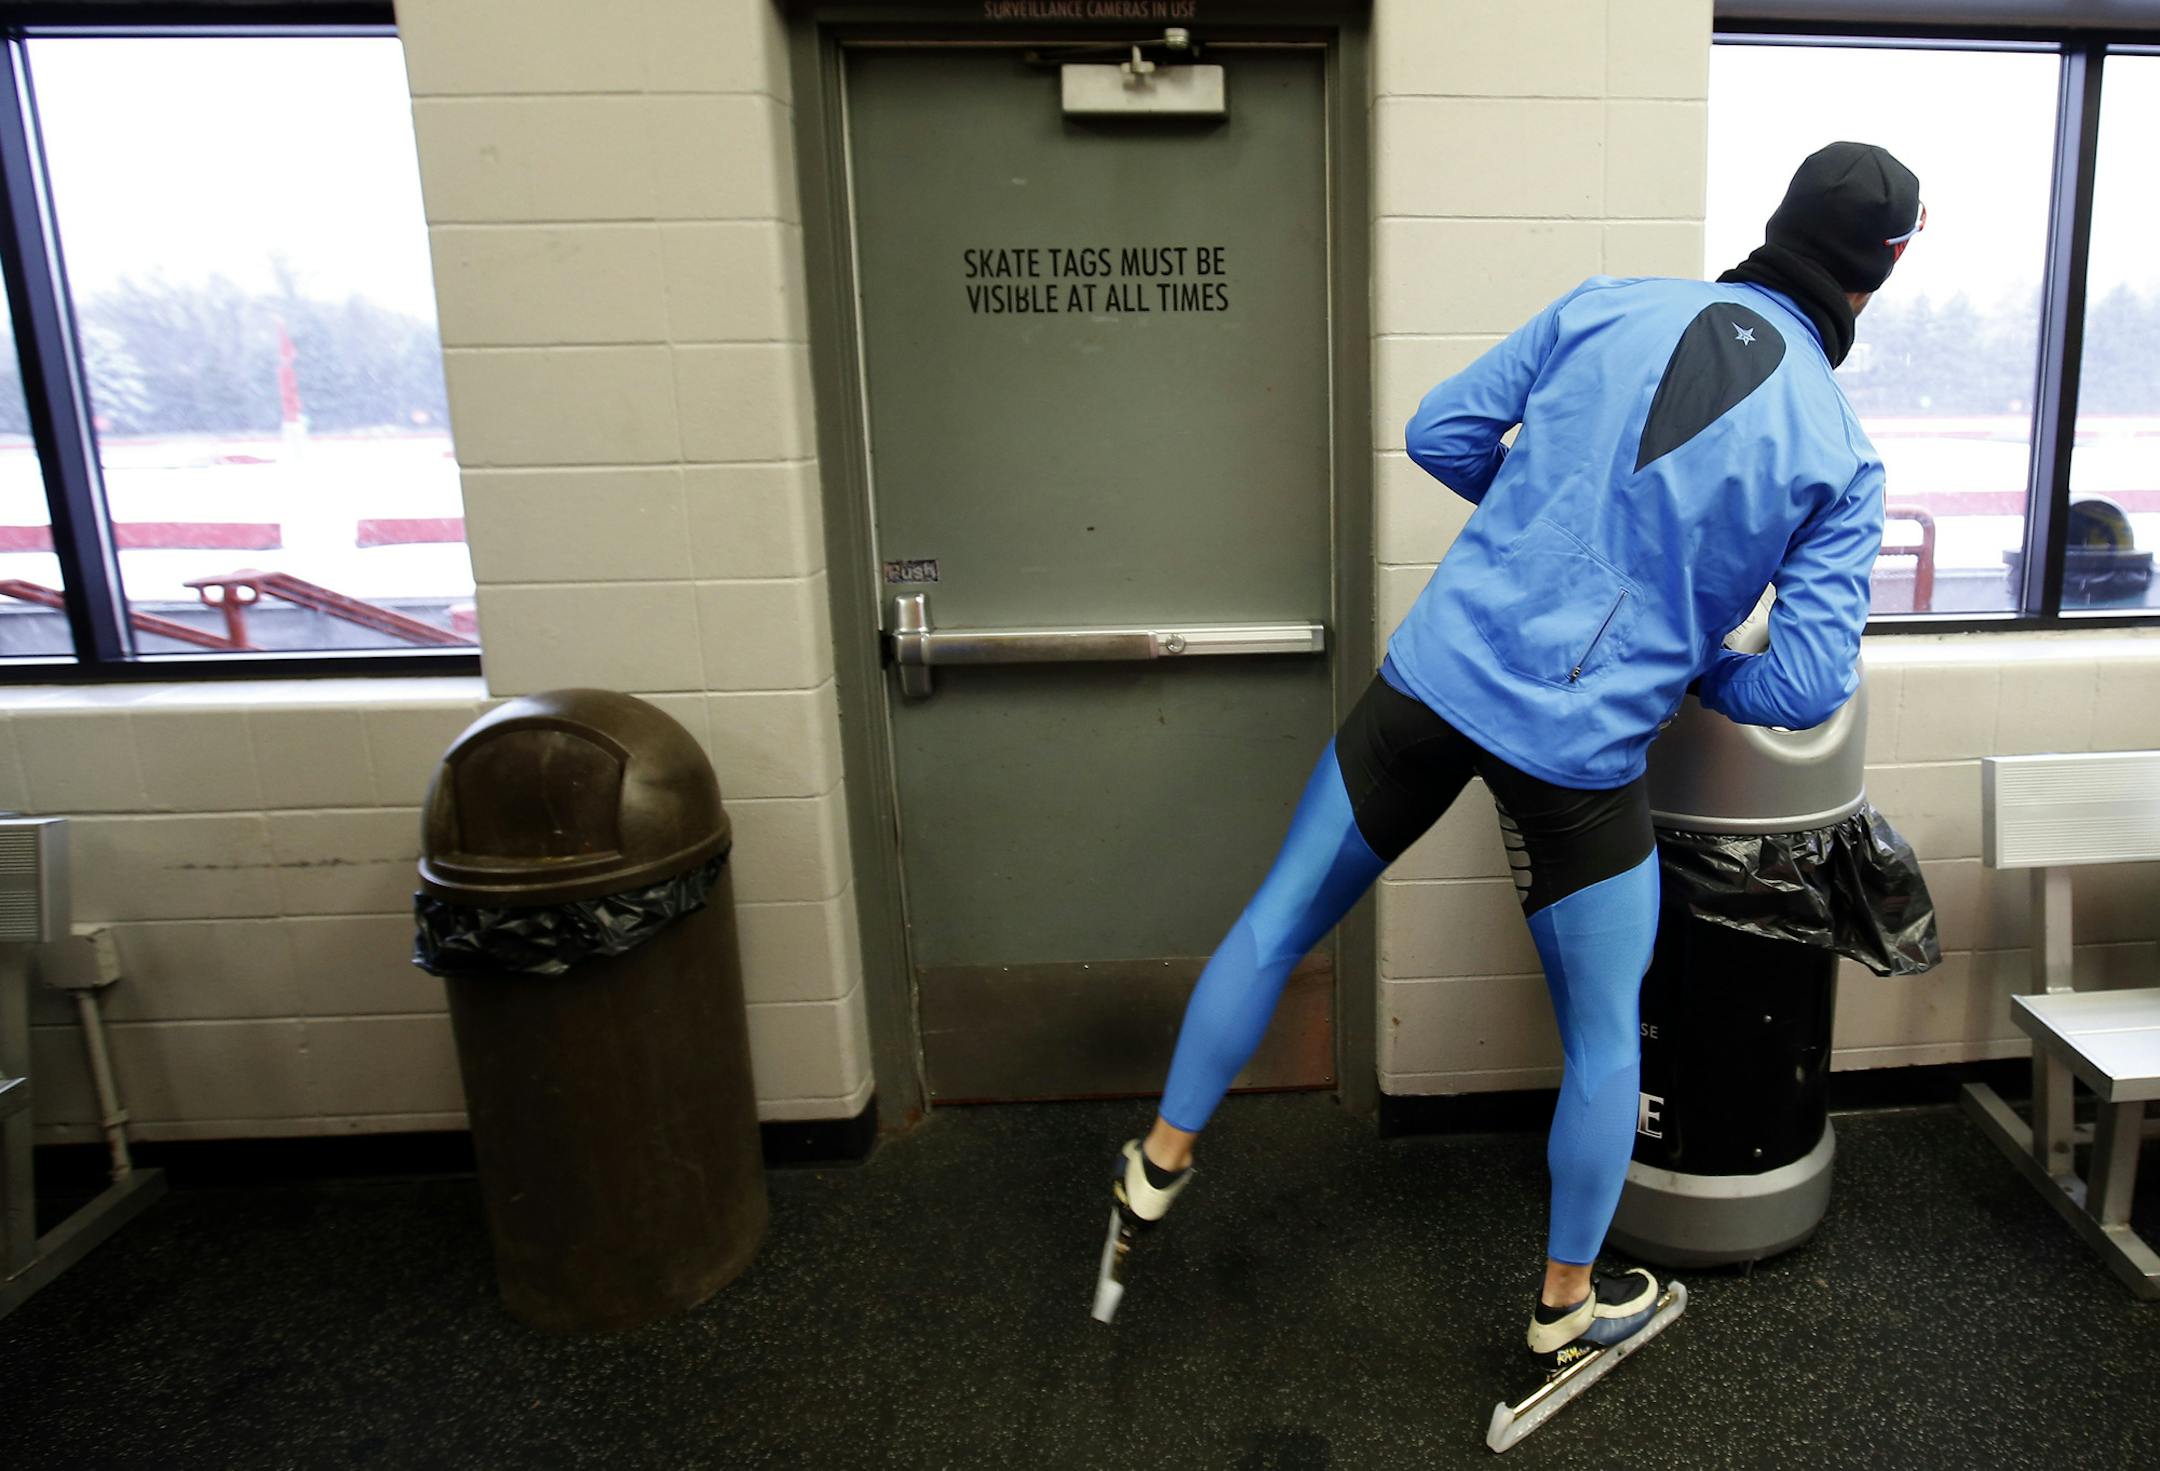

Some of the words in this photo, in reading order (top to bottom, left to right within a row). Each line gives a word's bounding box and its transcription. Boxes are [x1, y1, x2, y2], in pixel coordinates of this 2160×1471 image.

[984, 1, 1082, 18] SURVEILLANCE
[1086, 1, 1149, 17] CAMERAS
[1152, 1, 1167, 17] IN
[1171, 1, 1196, 17] USE
[964, 249, 1040, 278] SKATE
[1048, 248, 1112, 277] TAGS
[1121, 247, 1188, 276] MUST
[1196, 247, 1226, 275] BE
[966, 284, 1058, 313] VISIBLE
[1067, 284, 1097, 312] AT
[1105, 284, 1150, 312] ALL
[1156, 283, 1229, 311] TIMES
